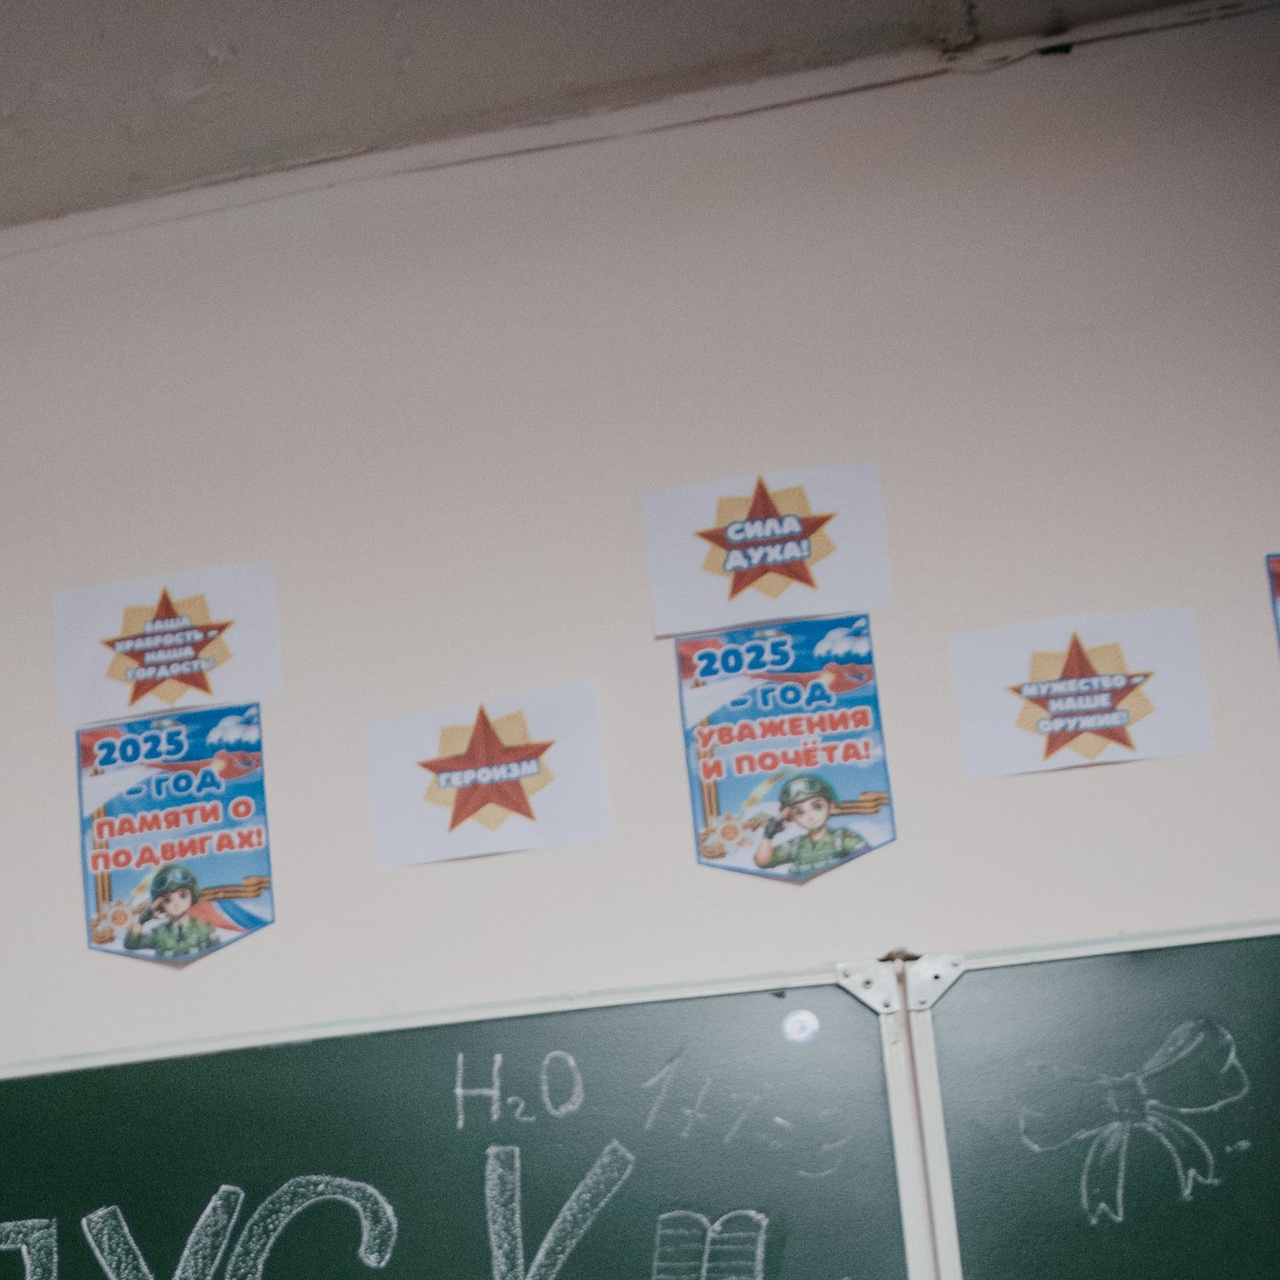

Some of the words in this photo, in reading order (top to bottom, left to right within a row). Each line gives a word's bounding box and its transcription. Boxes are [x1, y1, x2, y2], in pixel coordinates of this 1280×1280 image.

[725, 514, 802, 542] СИЛА
[723, 538, 811, 572] ДУХА!
[697, 641, 792, 678] 2025
[756, 681, 833, 709] ГОД
[1022, 674, 1127, 698] МУЖЕСТВО
[696, 706, 871, 750] УВАЖЕНИЯ
[97, 731, 185, 767] 2025
[701, 760, 723, 781] И
[734, 739, 871, 776] ПОЧЁТА!
[153, 768, 222, 798] ГОД
[437, 758, 540, 789] ГЕРОИЗМ
[94, 806, 220, 841] ПАМЯТИ
[231, 799, 253, 819] О
[90, 828, 264, 872] ПОДВИГАХ!
